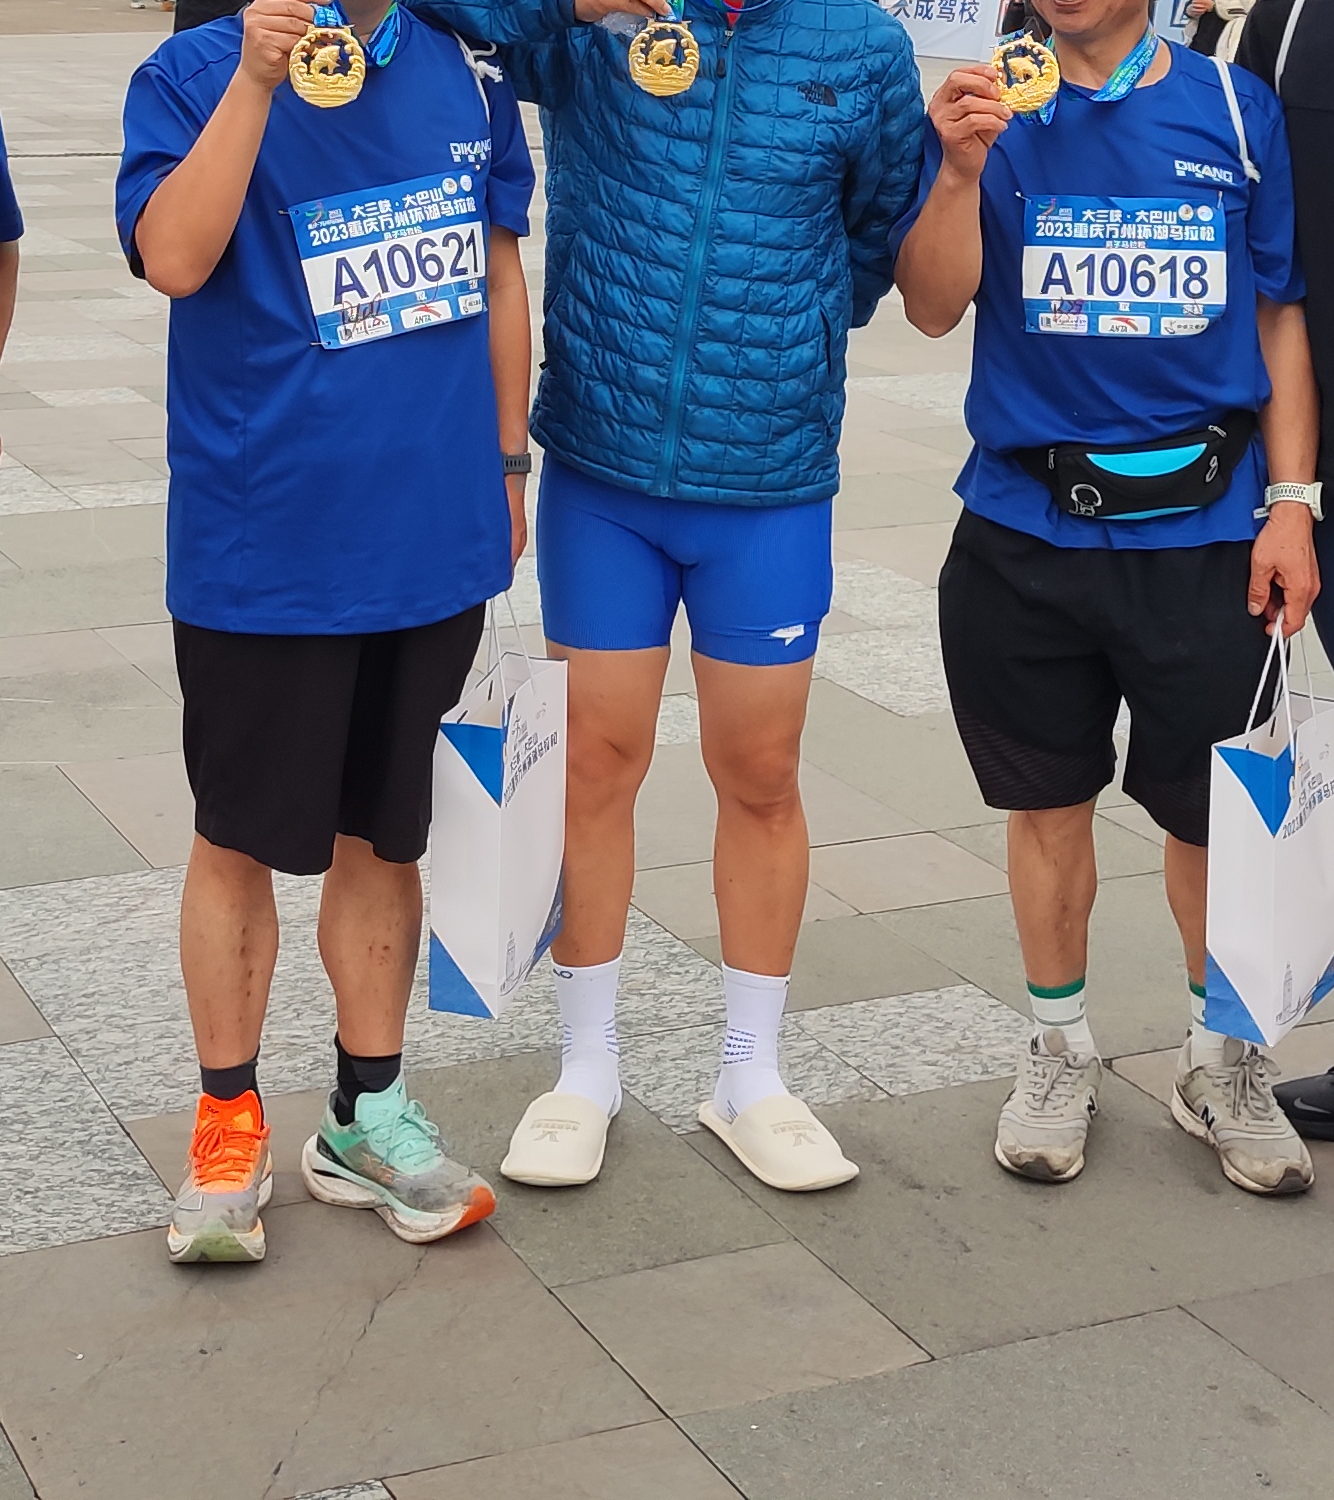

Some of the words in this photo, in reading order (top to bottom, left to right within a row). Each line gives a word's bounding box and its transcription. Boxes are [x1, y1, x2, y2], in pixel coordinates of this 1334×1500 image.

[1174, 159, 1233, 183] DIKANG
[309, 196, 477, 247] 2023重庆万州环湖马拉松
[1035, 222, 1215, 242] 2023重庆万州环湖马拉松
[333, 228, 479, 306] A10621
[1040, 252, 1209, 300] A10618
[414, 314, 432, 325] ANTA
[1108, 325, 1128, 333] ANTA
